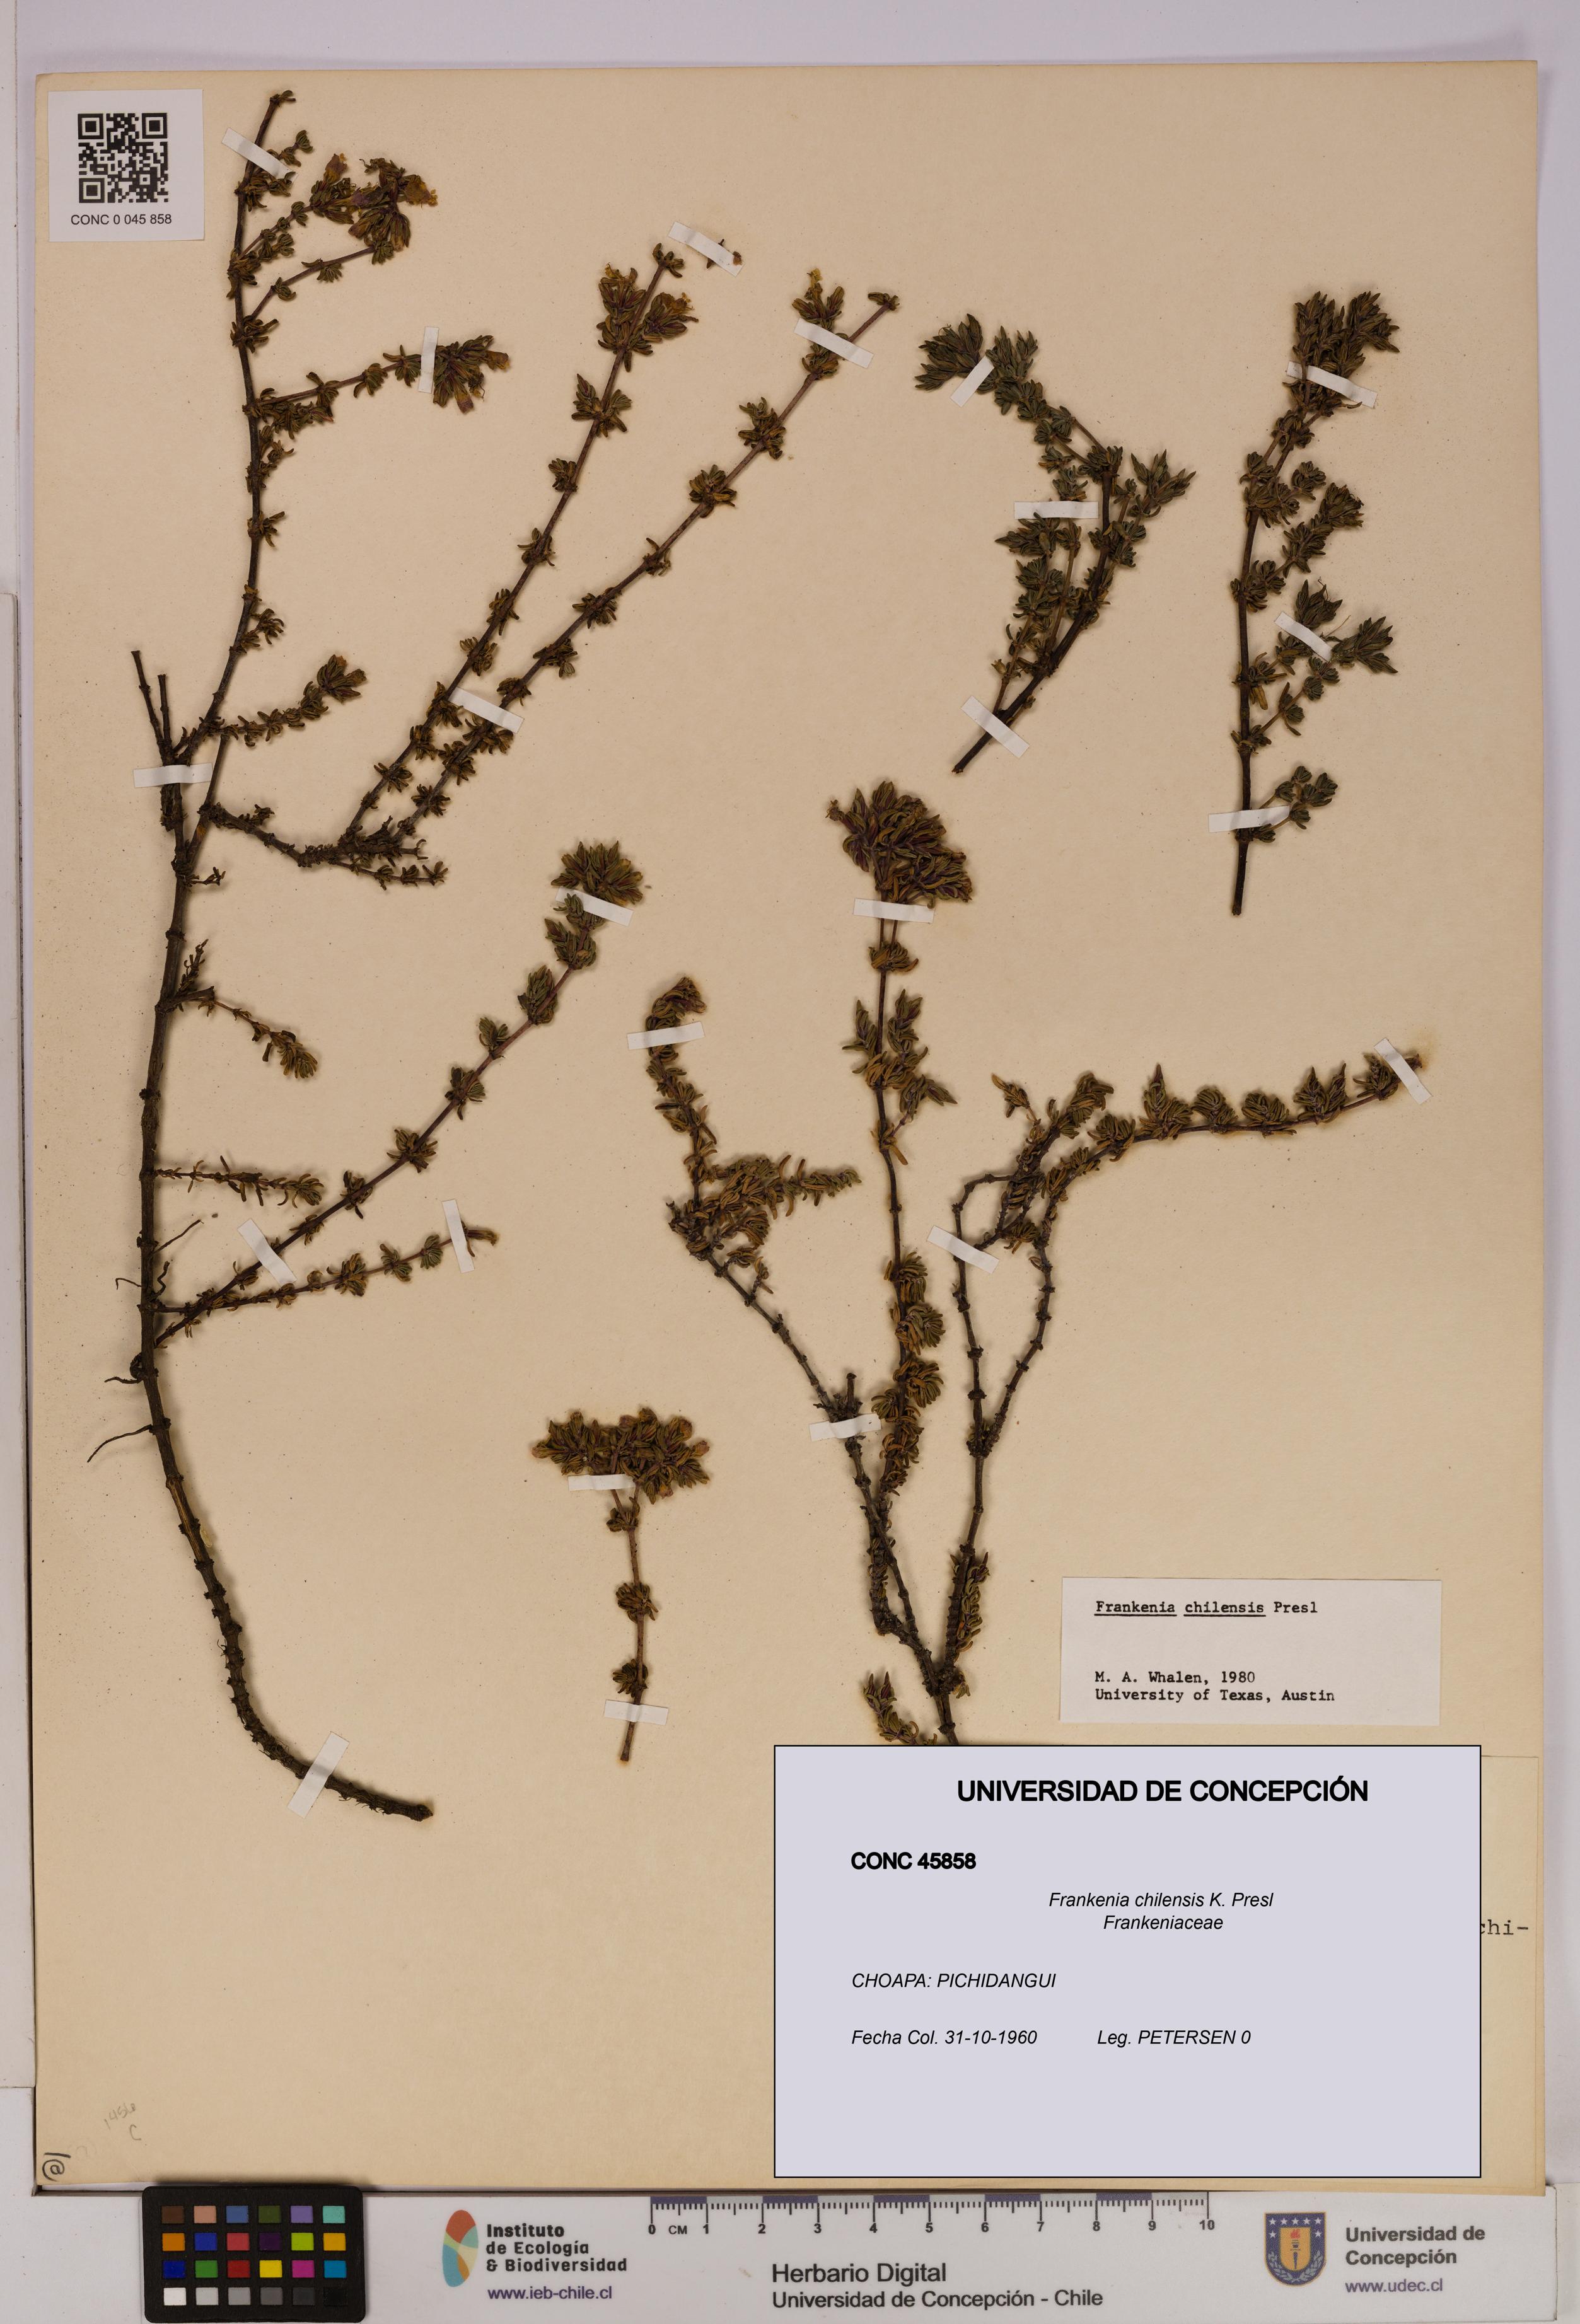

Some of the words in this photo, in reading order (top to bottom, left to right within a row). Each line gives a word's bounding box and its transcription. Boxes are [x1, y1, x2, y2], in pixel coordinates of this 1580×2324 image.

[71, 214, 110, 226] CONC
[113, 214, 120, 225] 0
[124, 214, 146, 225] 045
[150, 213, 172, 224] 858
[1093, 1600, 1178, 1617] Frankenia
[1183, 1601, 1267, 1617] chilensis
[1273, 1601, 1318, 1614] Presl
[1095, 1671, 1111, 1683] M.
[1121, 1671, 1137, 1683] A.
[1148, 1670, 1209, 1685] Whalen,
[1221, 1670, 1255, 1684] 1980
[1095, 1688, 1184, 1703] University
[1193, 1688, 1211, 1701] of
[1219, 1689, 1271, 1703] Texas,
[1281, 1689, 1335, 1701] Austin
[487, 2223, 565, 2238] Instituto
[648, 2223, 656, 2235] 0
[668, 2225, 688, 2235] CM
[702, 2223, 709, 2234] 1
[758, 2223, 766, 2234] 2
[813, 2223, 822, 2234] 3
[869, 2222, 878, 2234] 4
[925, 2222, 934, 2233] 5
[980, 2221, 989, 2233] 6
[1037, 2221, 1045, 2232] 7
[1092, 2221, 1101, 2232] 8
[1147, 2220, 1156, 2231] 9
[1199, 2219, 1215, 2231] 10
[1345, 2225, 1457, 2243] Universidad
[1462, 2225, 1485, 2241] de
[485, 2241, 507, 2255] de
[514, 2240, 589, 2257] Ecología
[486, 2258, 498, 2272] &
[505, 2257, 627, 2272] Biodiversidad
[1345, 2248, 1457, 2269] Concepción
[772, 2263, 869, 2283] Herbario
[877, 2262, 946, 2287] Digital
[1344, 2277, 1443, 2293] www.udec.cl
[487, 2286, 612, 2299] www.ieb-chile.cl
[772, 2291, 885, 2308] Universidad
[891, 2291, 915, 2308] de
[921, 2289, 1035, 2311] Concepción
[1054, 2289, 1103, 2306] Chile
